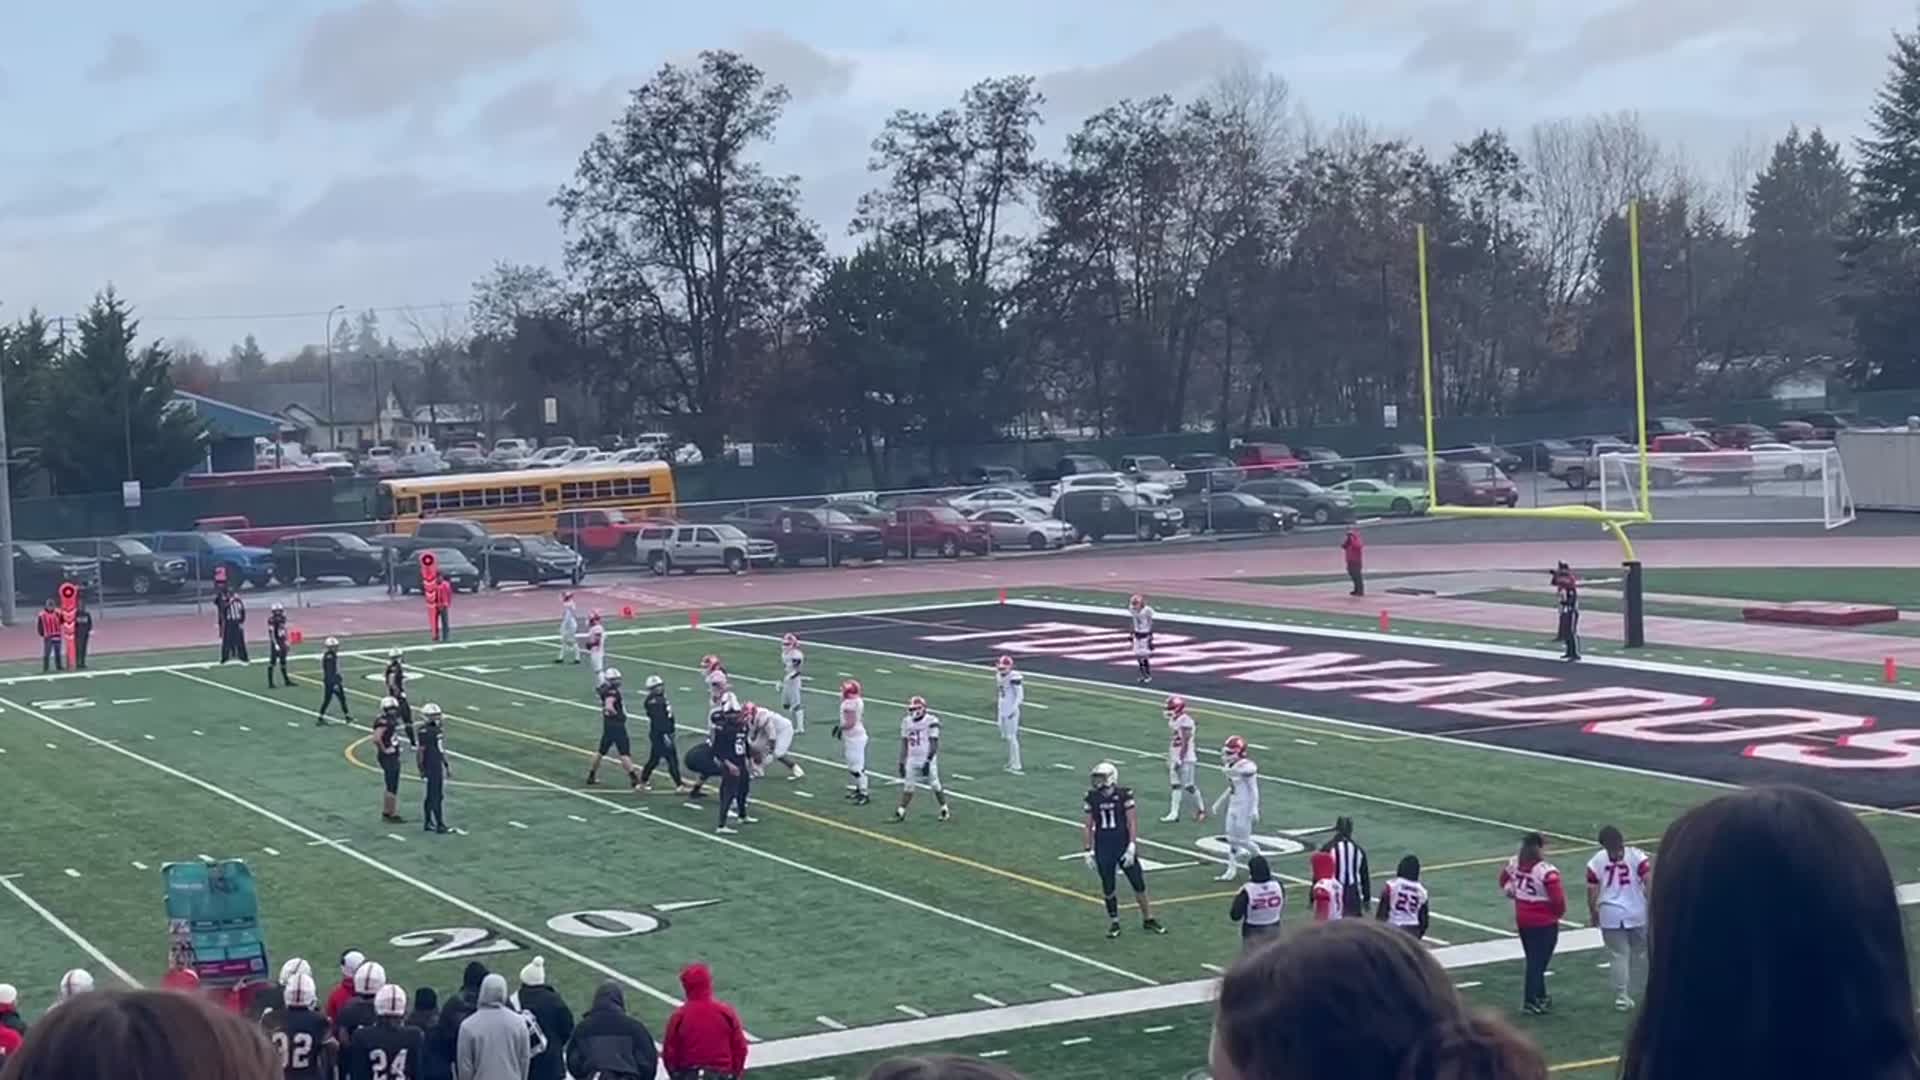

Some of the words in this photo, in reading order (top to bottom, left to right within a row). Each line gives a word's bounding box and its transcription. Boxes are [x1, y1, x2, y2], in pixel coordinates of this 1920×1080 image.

[1100, 809, 1116, 829] 11
[1604, 863, 1631, 888] 72
[1251, 896, 1281, 910] 20
